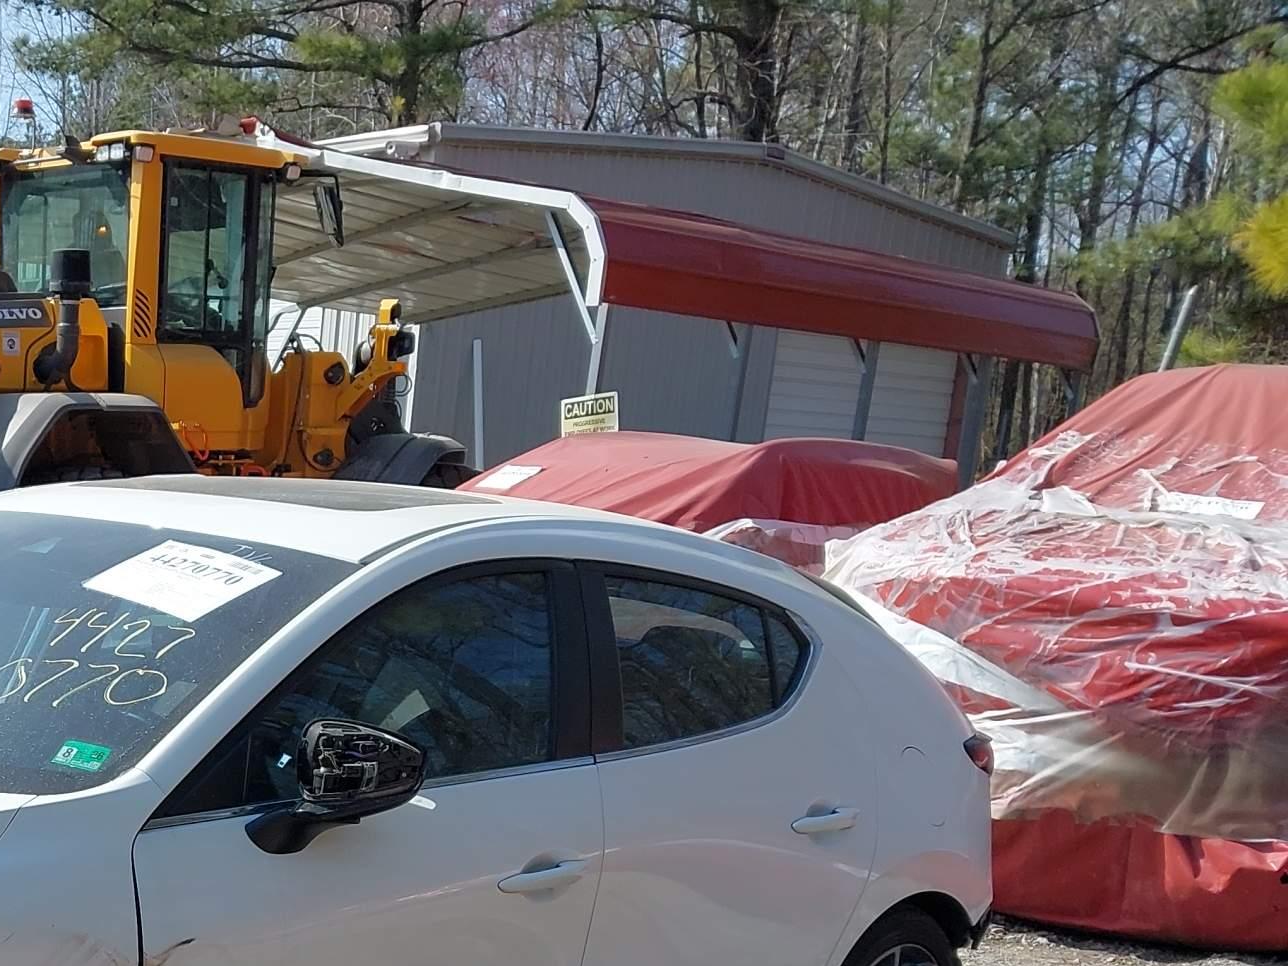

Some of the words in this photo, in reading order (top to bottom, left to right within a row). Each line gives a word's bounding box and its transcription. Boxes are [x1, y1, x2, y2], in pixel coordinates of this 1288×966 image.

[565, 398, 614, 418] CAUTION
[149, 553, 244, 586] 44270770
[50, 607, 196, 660] 4427
[63, 748, 73, 757] 8
